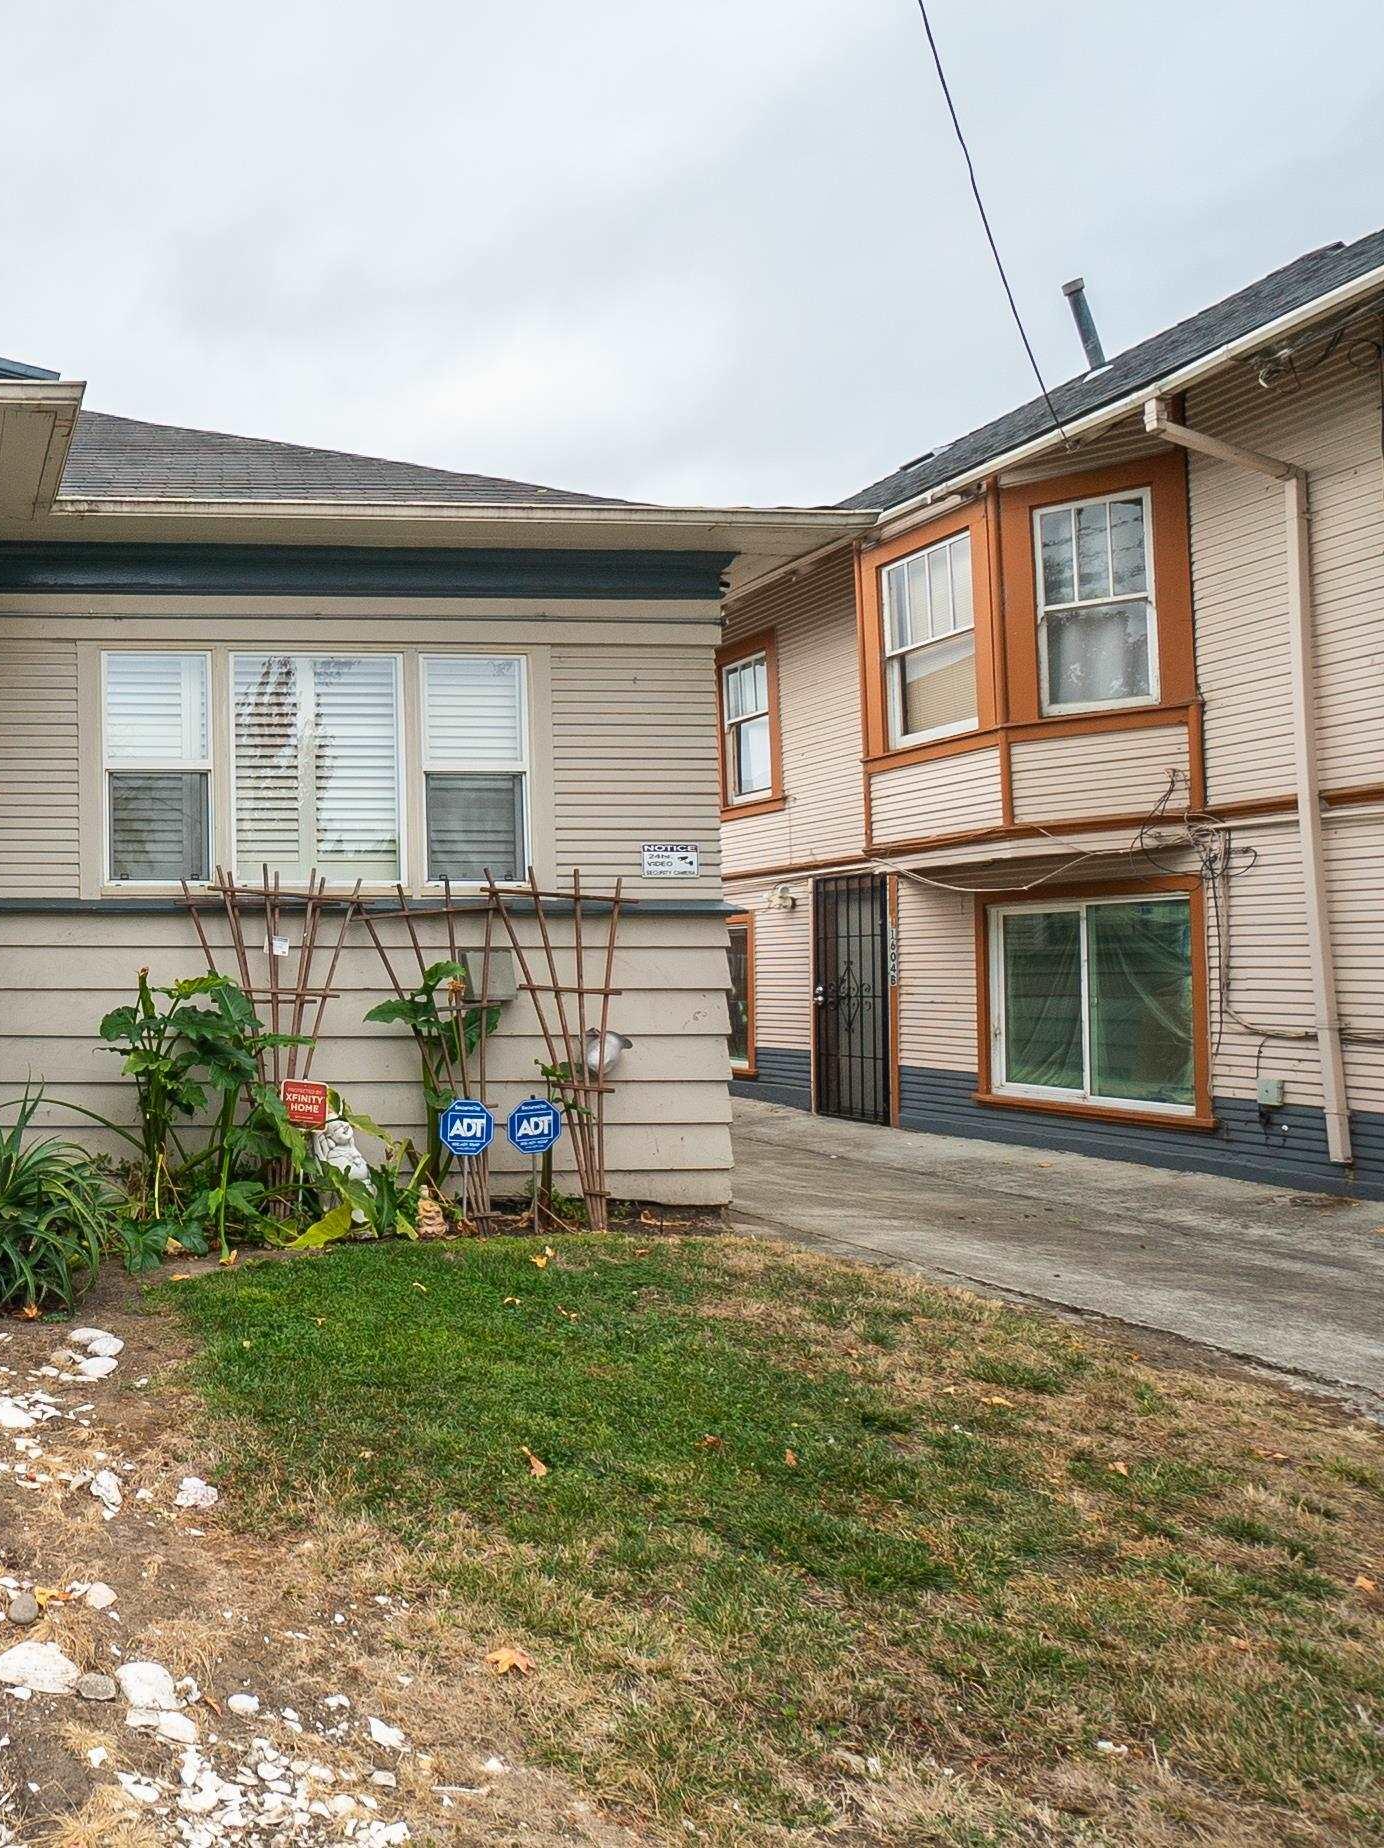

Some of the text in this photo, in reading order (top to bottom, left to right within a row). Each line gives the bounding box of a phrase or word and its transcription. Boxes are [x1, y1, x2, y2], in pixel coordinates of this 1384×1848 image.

[285, 1092, 323, 1104] XFINITY
[290, 1103, 320, 1114] HOME
[449, 1118, 486, 1138] ADT
[517, 1115, 552, 1137] ADT
